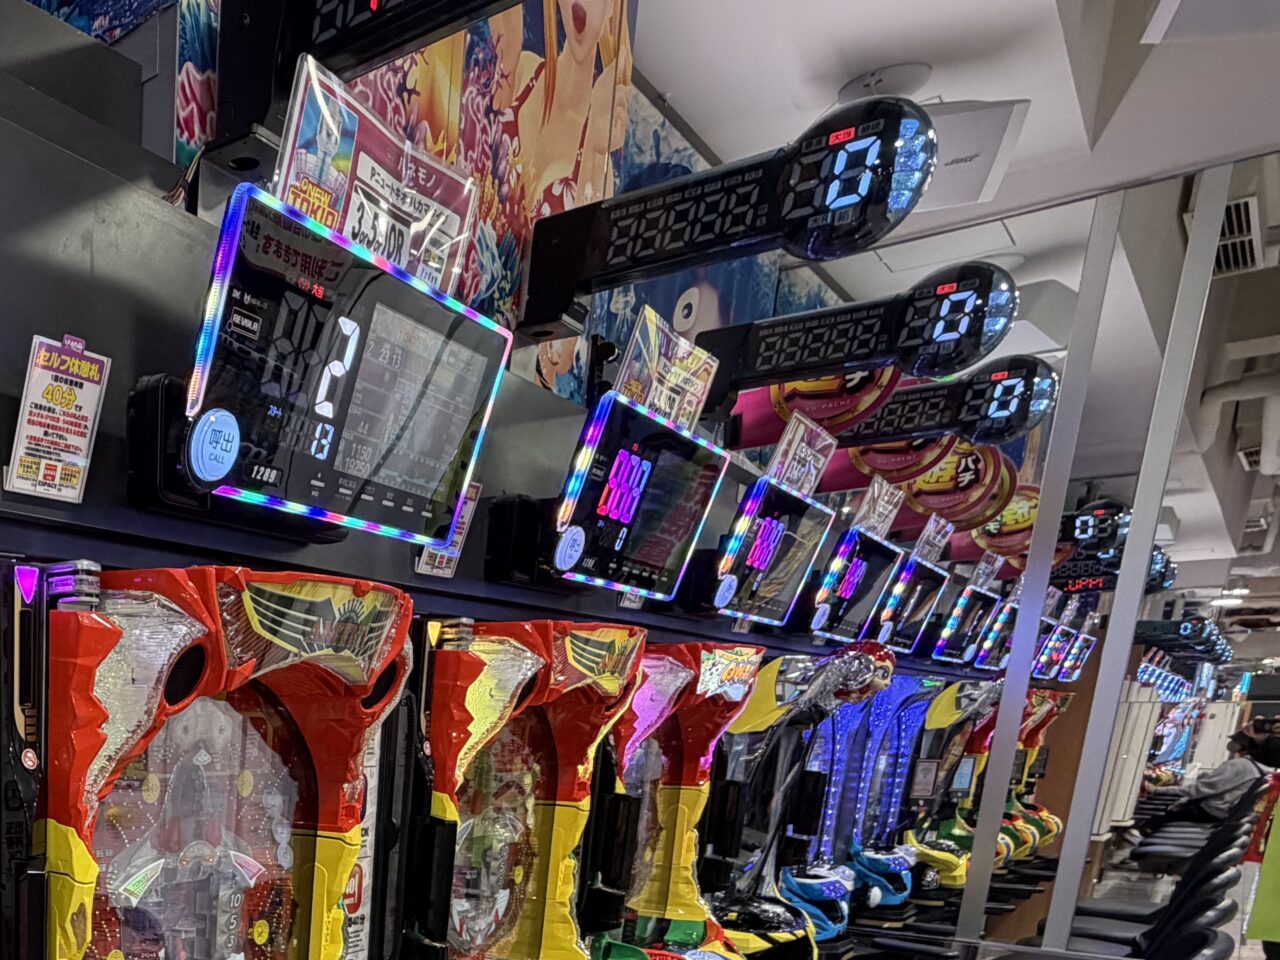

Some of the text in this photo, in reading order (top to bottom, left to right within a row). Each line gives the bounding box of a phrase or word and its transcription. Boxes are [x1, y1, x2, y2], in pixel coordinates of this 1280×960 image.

[825, 136, 881, 209] 0
[933, 290, 977, 341] 0
[42, 383, 77, 410] 40分
[988, 378, 1025, 418] 0
[209, 428, 235, 453] 呼出
[208, 452, 225, 465] CALL
[230, 892, 242, 908] 10
[229, 914, 238, 930] 5
